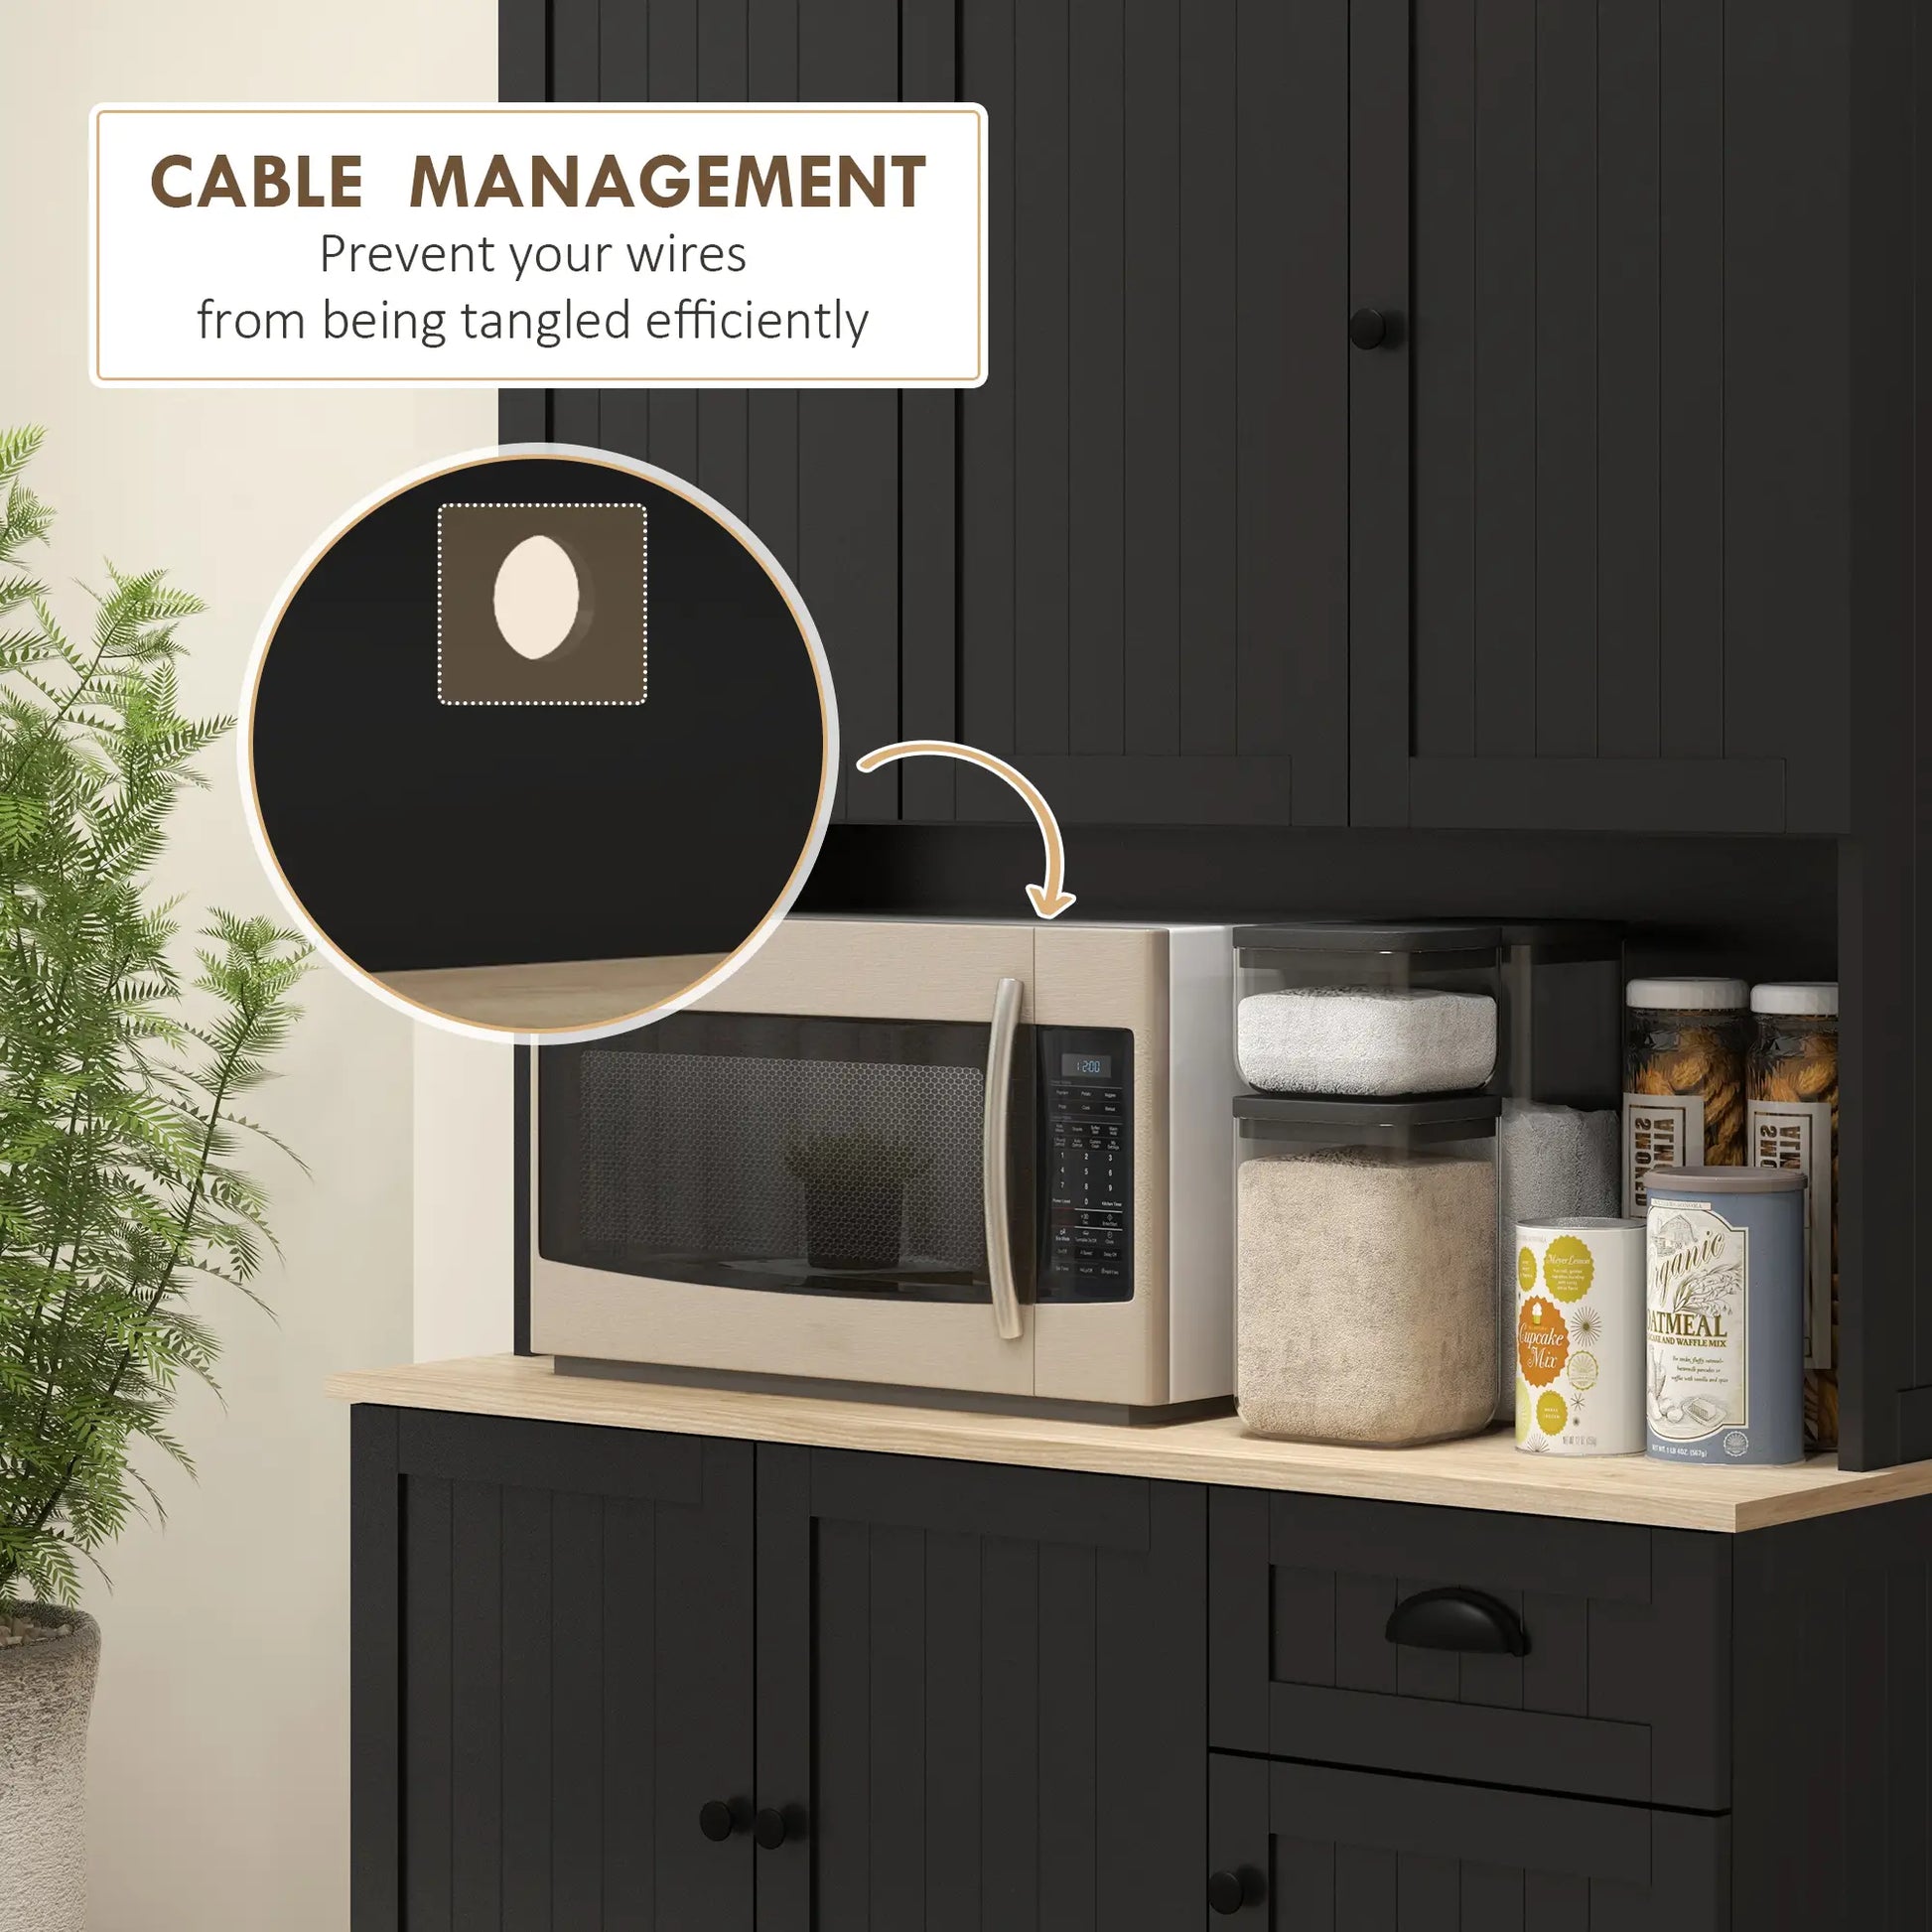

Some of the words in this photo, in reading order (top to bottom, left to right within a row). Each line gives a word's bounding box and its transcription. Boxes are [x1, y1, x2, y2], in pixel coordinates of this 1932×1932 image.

[1519, 1322, 1566, 1350] Cupcake
[1661, 1336, 1676, 1345] AND
[1676, 1337, 1708, 1348] WAFFLE
[1708, 1339, 1727, 1348] MIX
[1527, 1346, 1558, 1369] Mix
